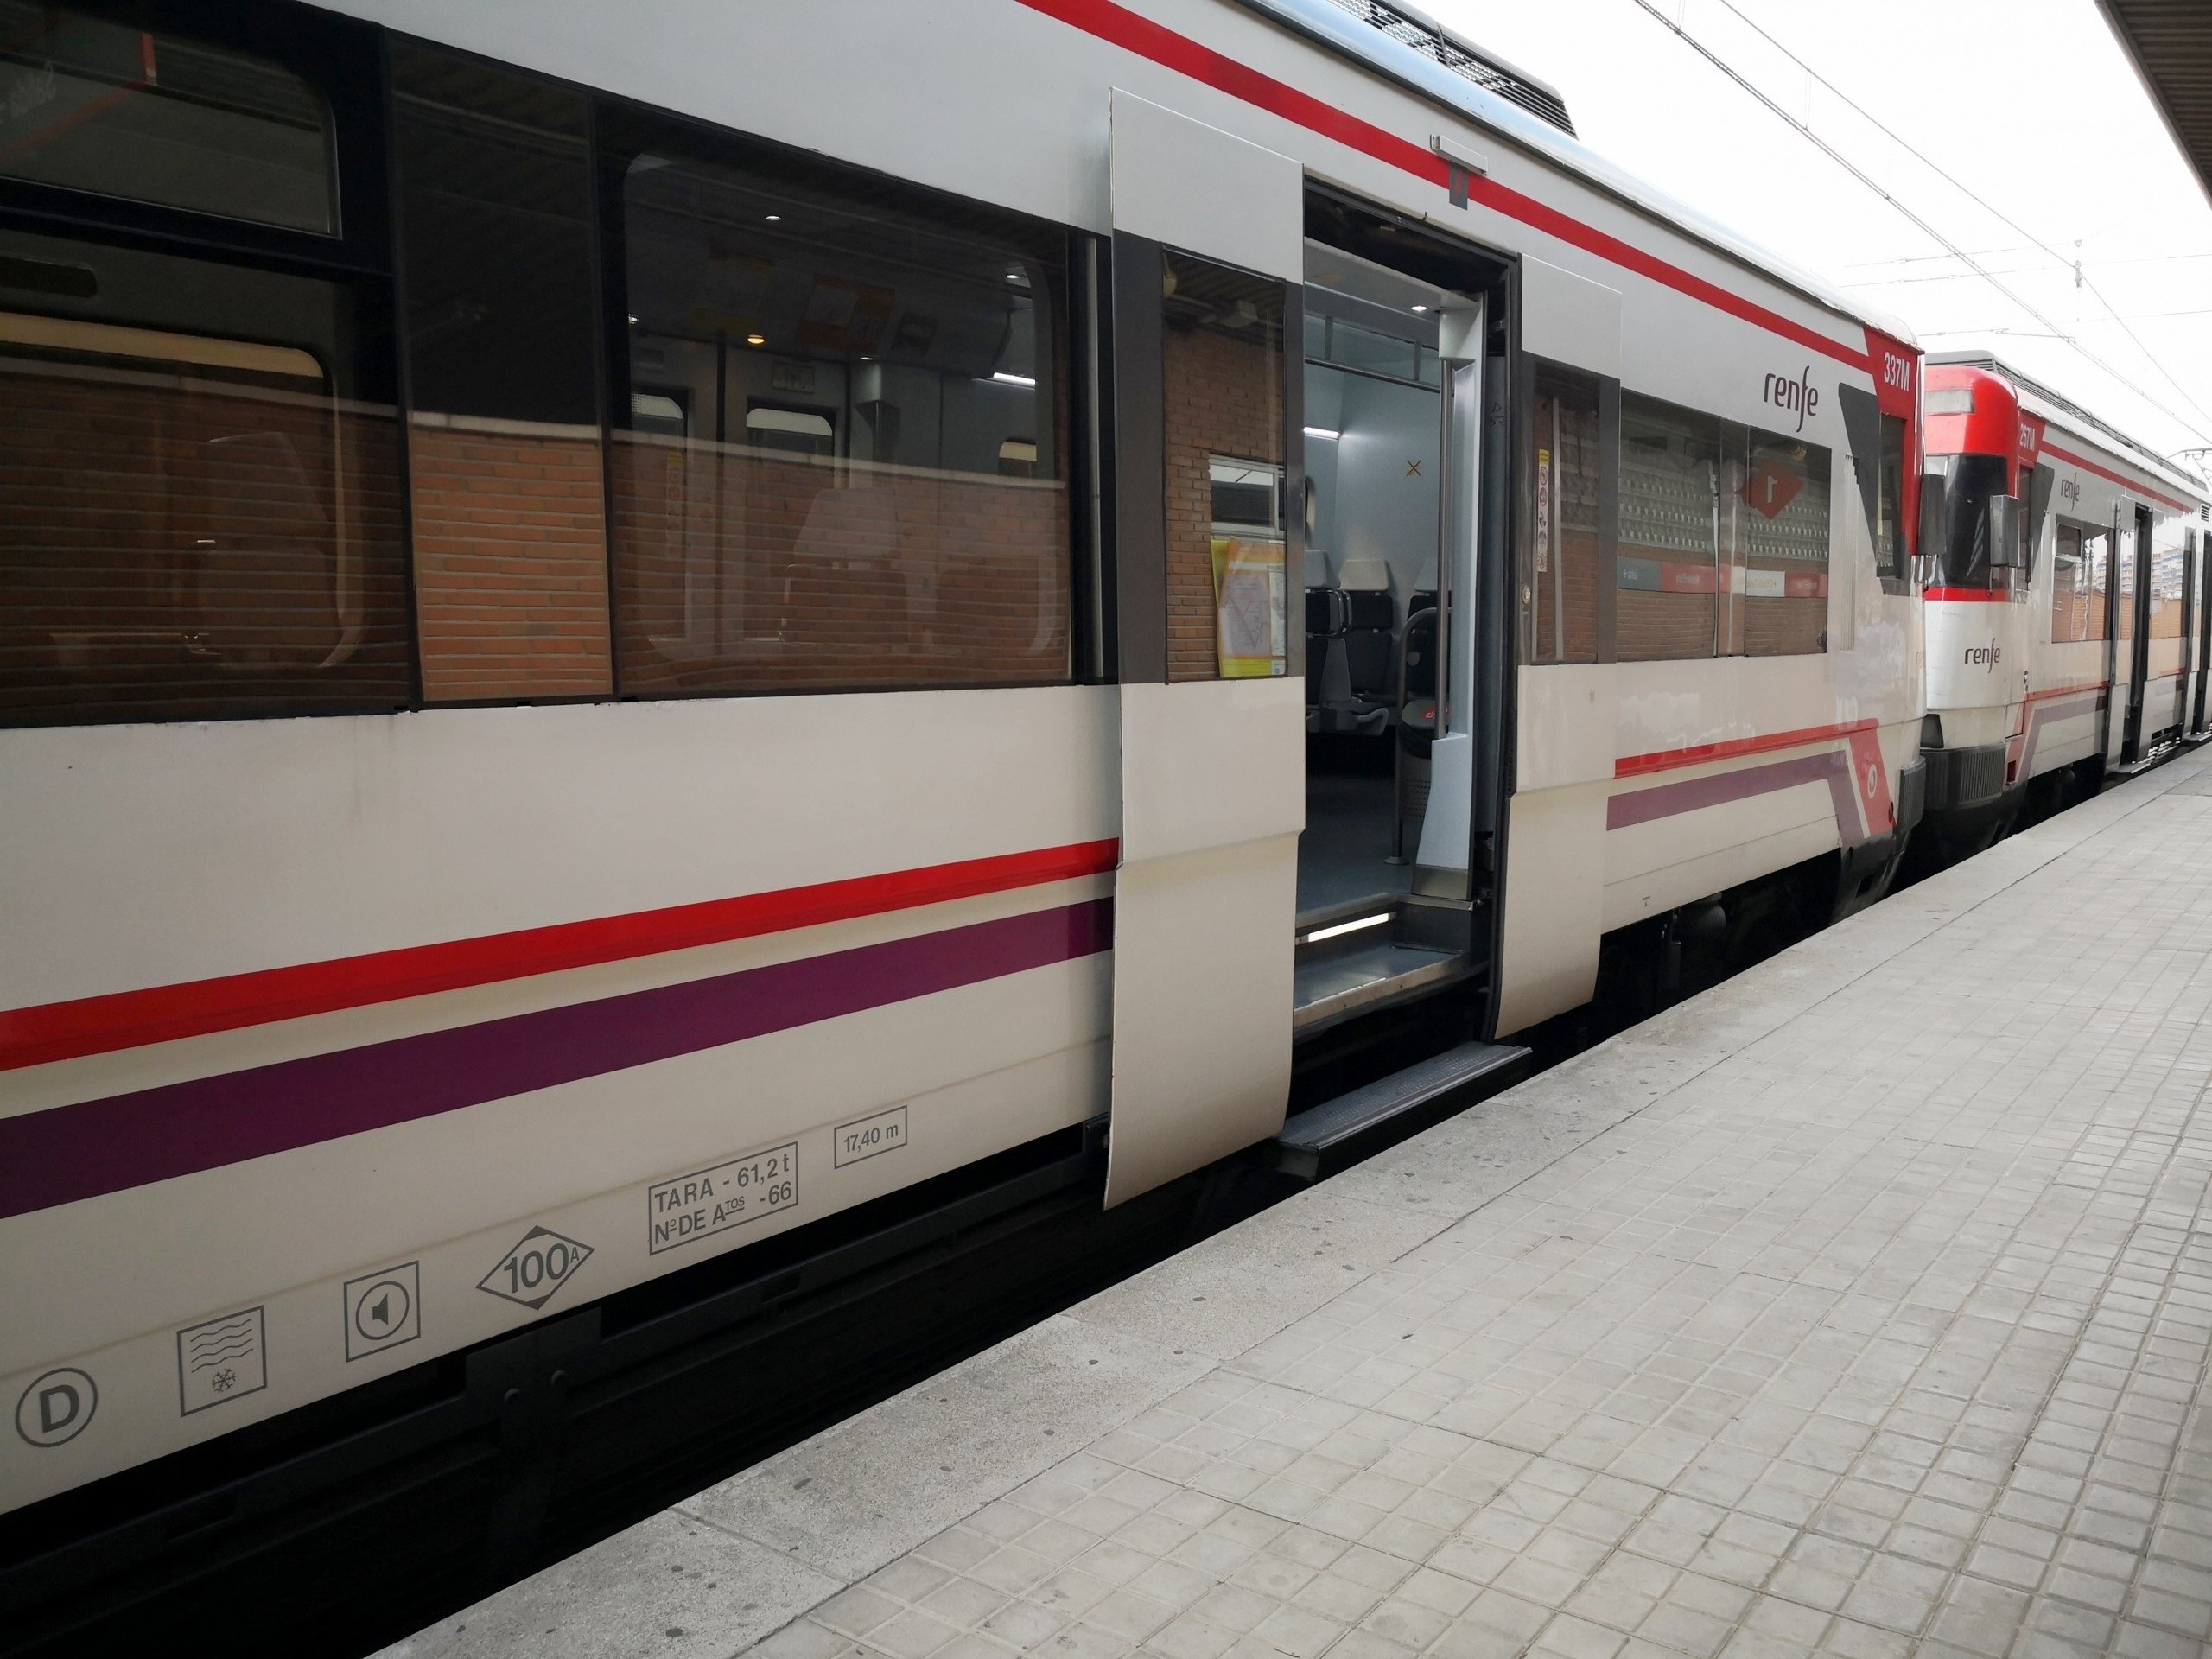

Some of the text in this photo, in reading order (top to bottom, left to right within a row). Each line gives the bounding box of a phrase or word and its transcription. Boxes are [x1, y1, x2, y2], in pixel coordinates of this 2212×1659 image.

[1883, 351, 1910, 392] 337M
[1763, 365, 1819, 433] renfe
[2019, 423, 2036, 452] 267M
[2060, 472, 2081, 512] renfe
[1964, 638, 2001, 674] renfe
[843, 1124, 899, 1153] 17,40 m
[654, 1177, 715, 1213] TARA
[737, 1158, 779, 1188] 61,2
[782, 1154, 790, 1173] t
[39, 1384, 80, 1433] D
